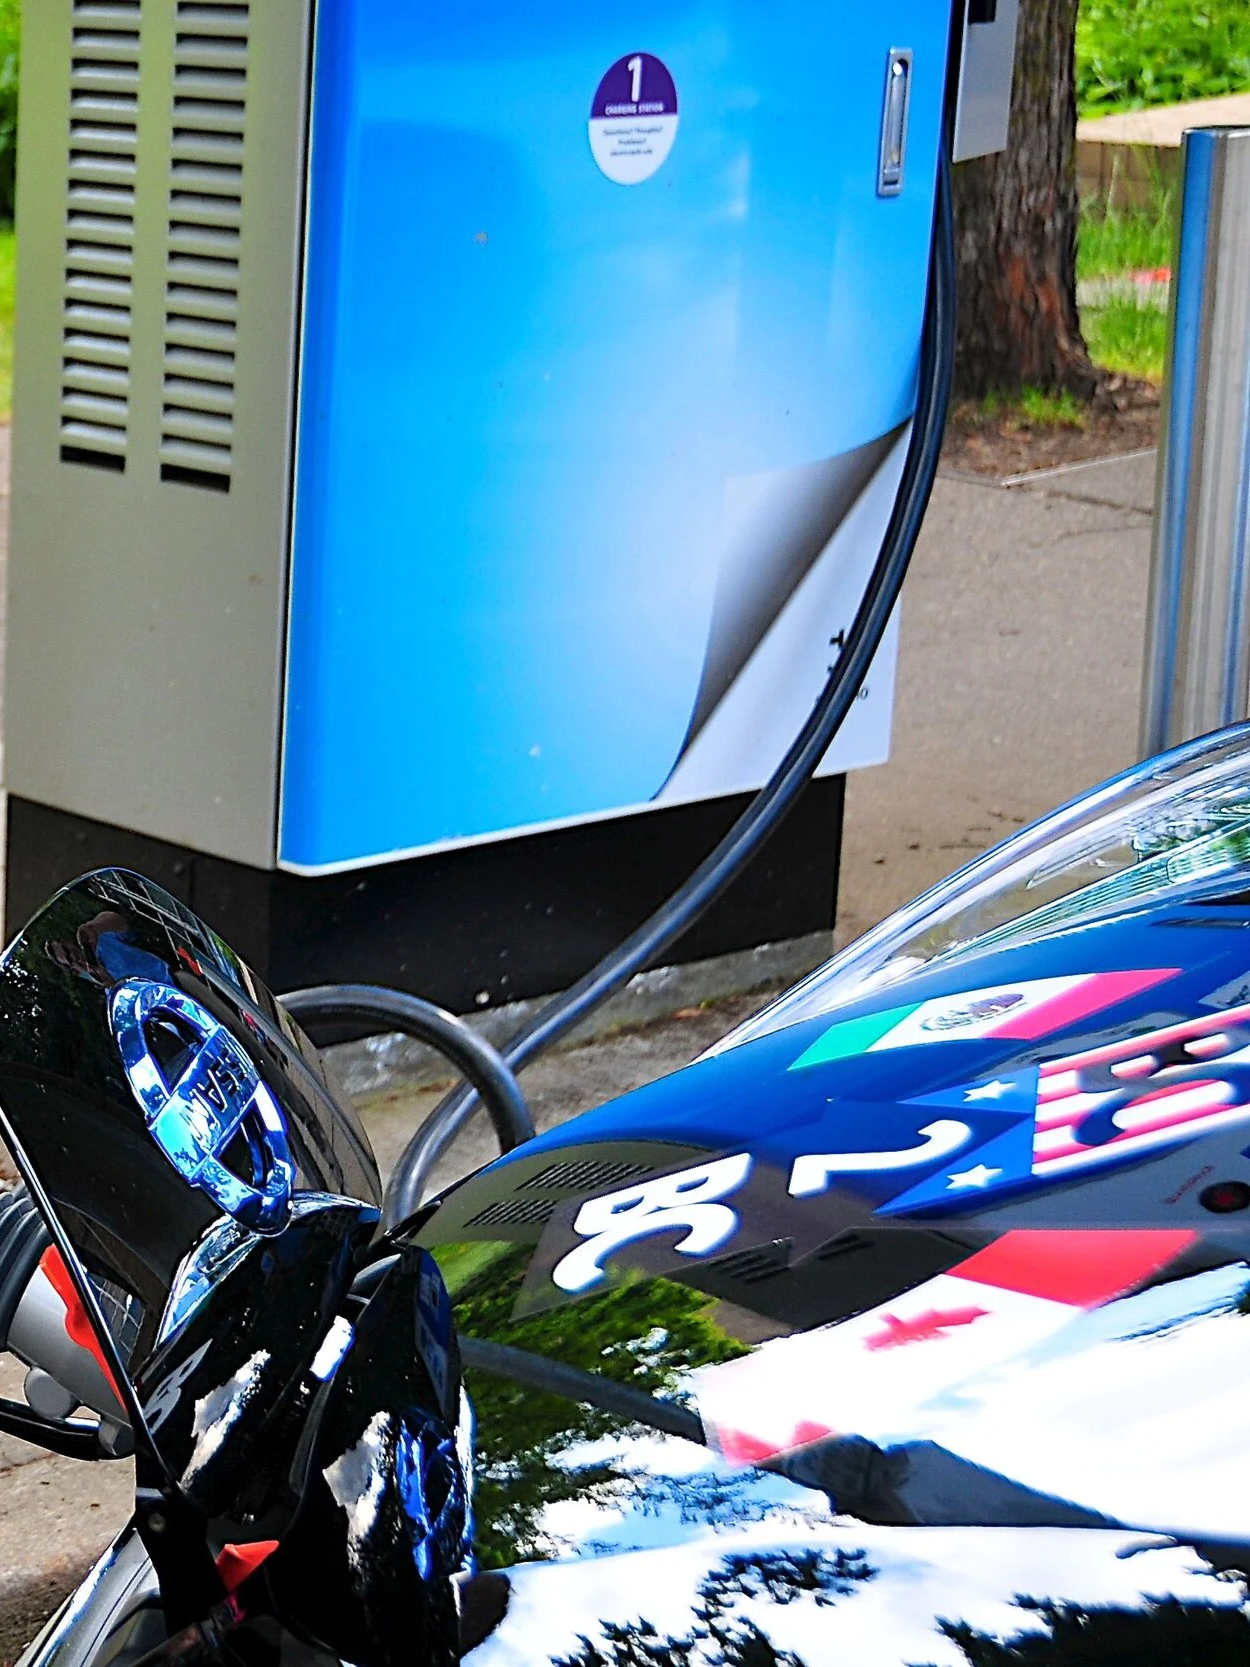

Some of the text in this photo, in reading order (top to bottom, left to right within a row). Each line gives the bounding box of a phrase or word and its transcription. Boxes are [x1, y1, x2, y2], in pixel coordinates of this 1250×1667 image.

[627, 55, 643, 103] 1
[605, 102, 664, 116] CHARGING STATION
[551, 1151, 752, 1294] BC
